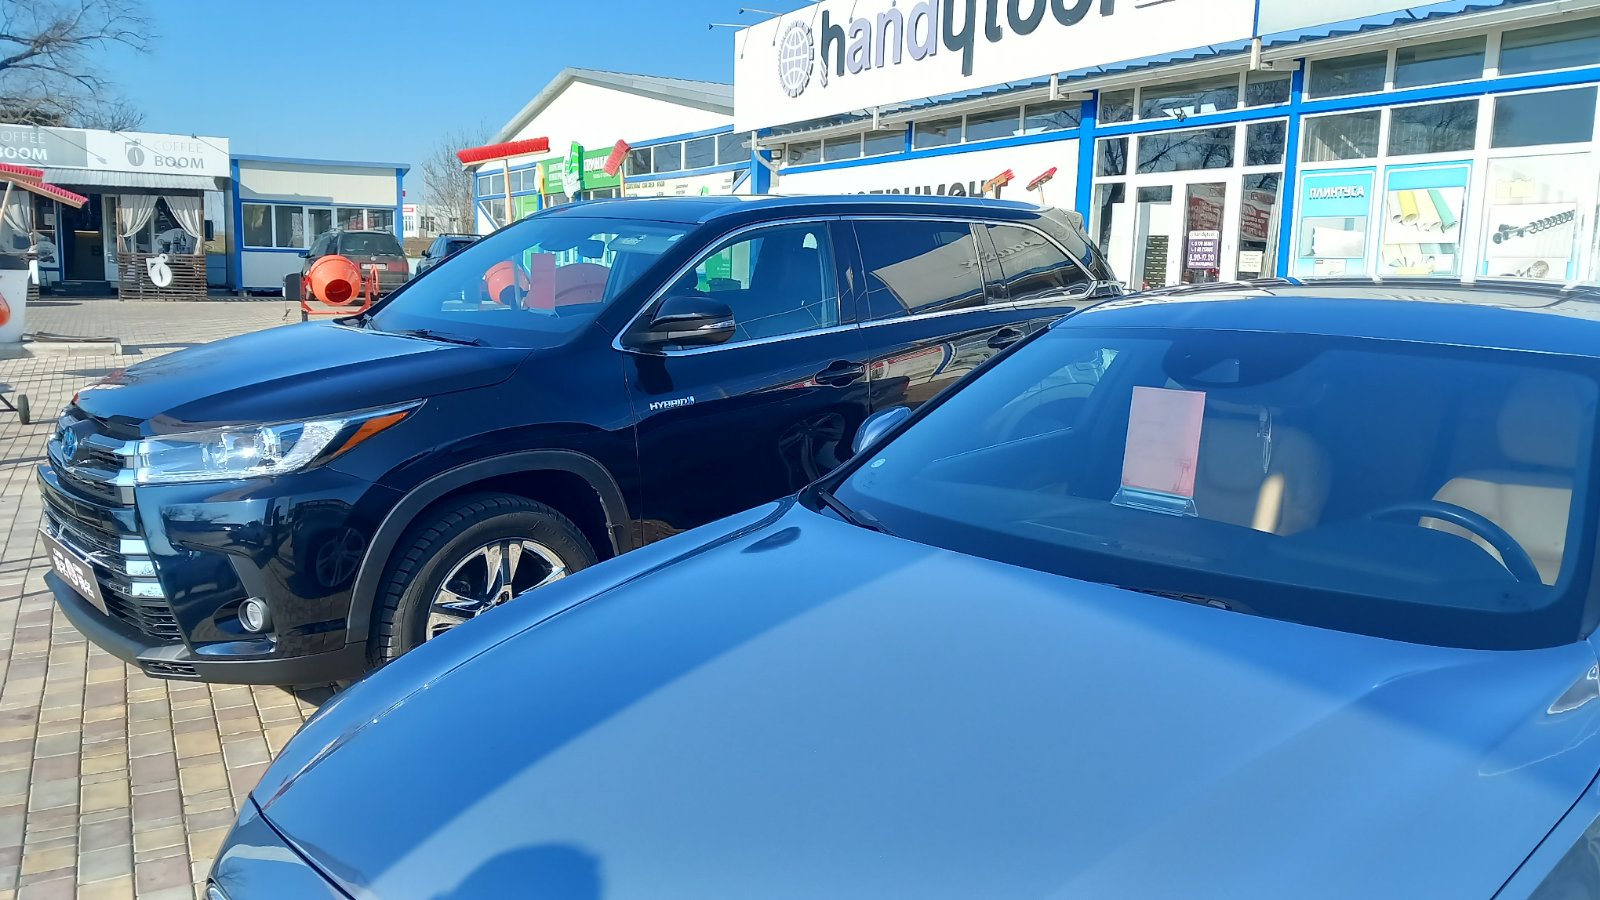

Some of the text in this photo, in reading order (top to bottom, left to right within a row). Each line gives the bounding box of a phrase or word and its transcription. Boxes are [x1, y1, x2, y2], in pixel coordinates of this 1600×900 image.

[821, 0, 1114, 77] handyto
[153, 141, 203, 153] COFFEE
[154, 155, 204, 169] BOOM
[1309, 185, 1365, 200] ПЛИНТУСА
[649, 398, 688, 411] HYBRID
